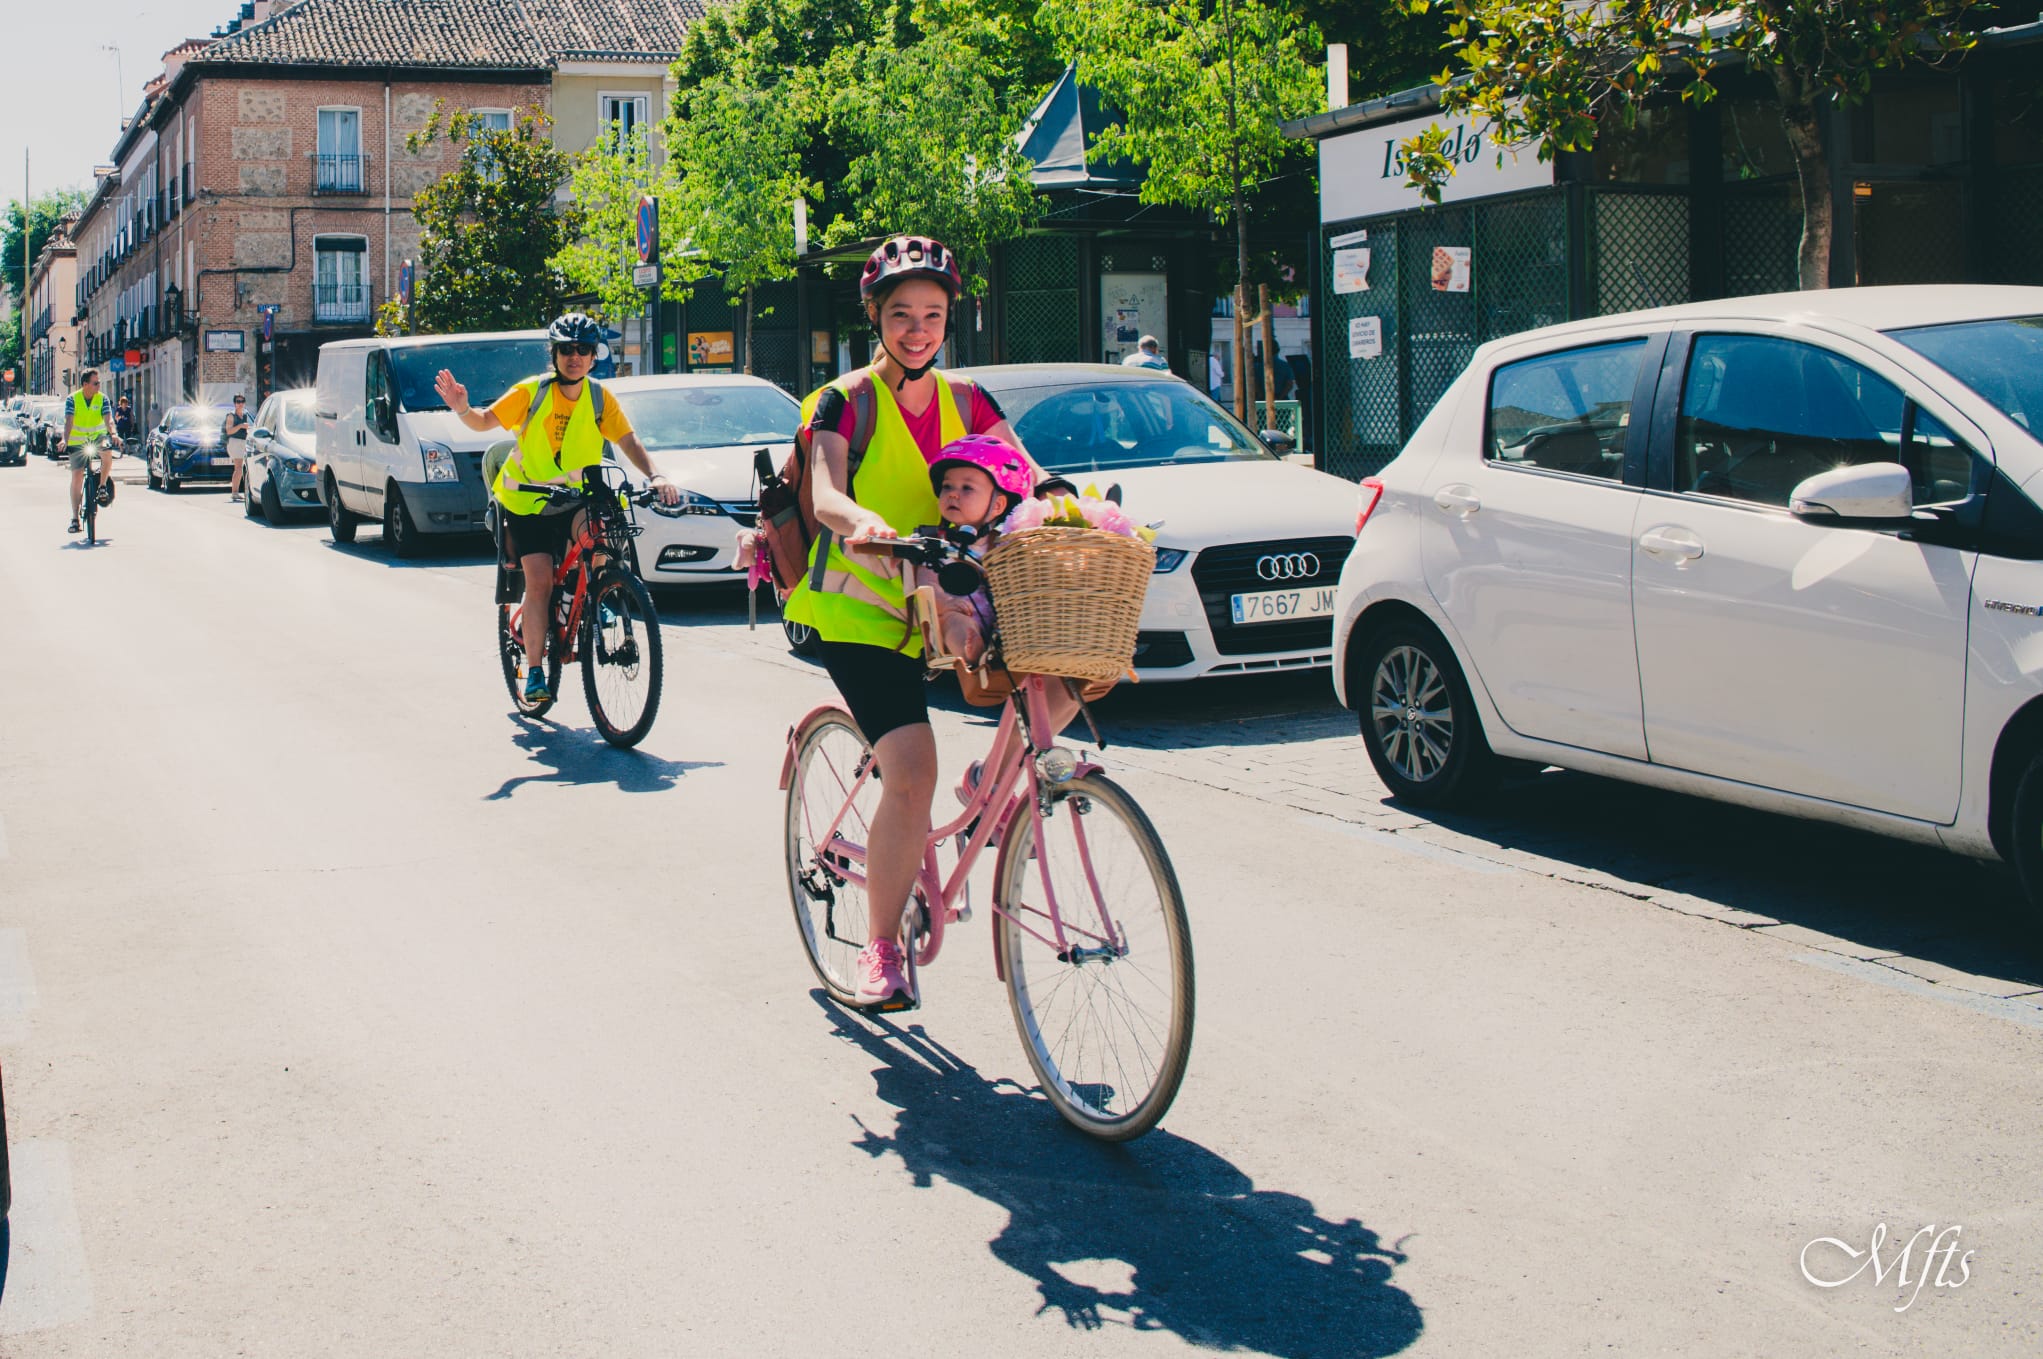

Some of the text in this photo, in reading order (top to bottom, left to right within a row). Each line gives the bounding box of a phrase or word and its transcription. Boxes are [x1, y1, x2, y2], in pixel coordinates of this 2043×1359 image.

[1381, 124, 1481, 179] Iselo
[1247, 590, 1338, 618] 7667 JM
